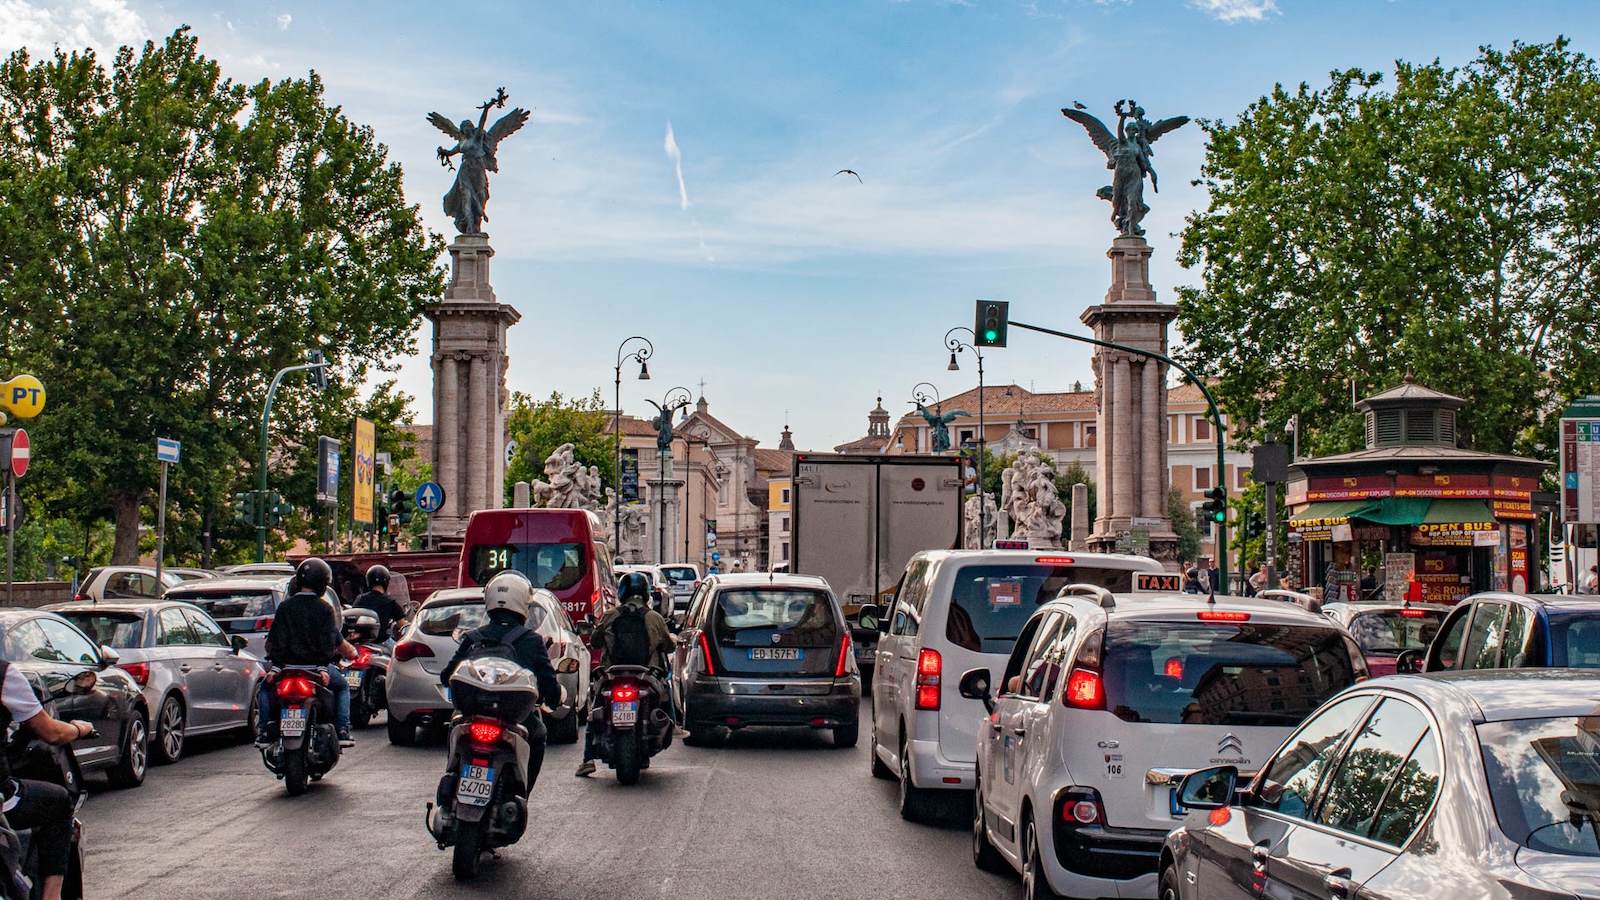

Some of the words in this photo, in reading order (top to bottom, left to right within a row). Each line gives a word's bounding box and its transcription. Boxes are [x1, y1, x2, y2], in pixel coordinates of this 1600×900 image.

[12, 387, 41, 406] PT
[1579, 426, 1585, 434] X
[1592, 426, 1599, 434] U
[1493, 501, 1502, 509] BUY
[1502, 501, 1520, 510] TICKETS
[1520, 502, 1531, 511] HERE
[1289, 519, 1321, 528] OPEN
[1323, 516, 1348, 526] BUS
[1418, 523, 1459, 532] OPEN
[1463, 522, 1493, 531] BUS
[997, 541, 1028, 549] TAXI
[488, 549, 508, 569] 34
[1511, 551, 1525, 560] SCAN
[1511, 560, 1525, 568] CODE
[1139, 576, 1179, 590] TAXI
[1443, 585, 1470, 595] ROME
[561, 601, 587, 612] 5817
[753, 649, 766, 659] ED
[769, 649, 799, 659] 157FY
[618, 702, 628, 711] EP
[287, 709, 297, 719] ET
[613, 712, 635, 721] 54181
[281, 720, 305, 729] 28280
[1097, 740, 1120, 749] C3
[470, 766, 483, 779] EB
[1107, 764, 1122, 774] 106
[460, 780, 491, 796] 54709
